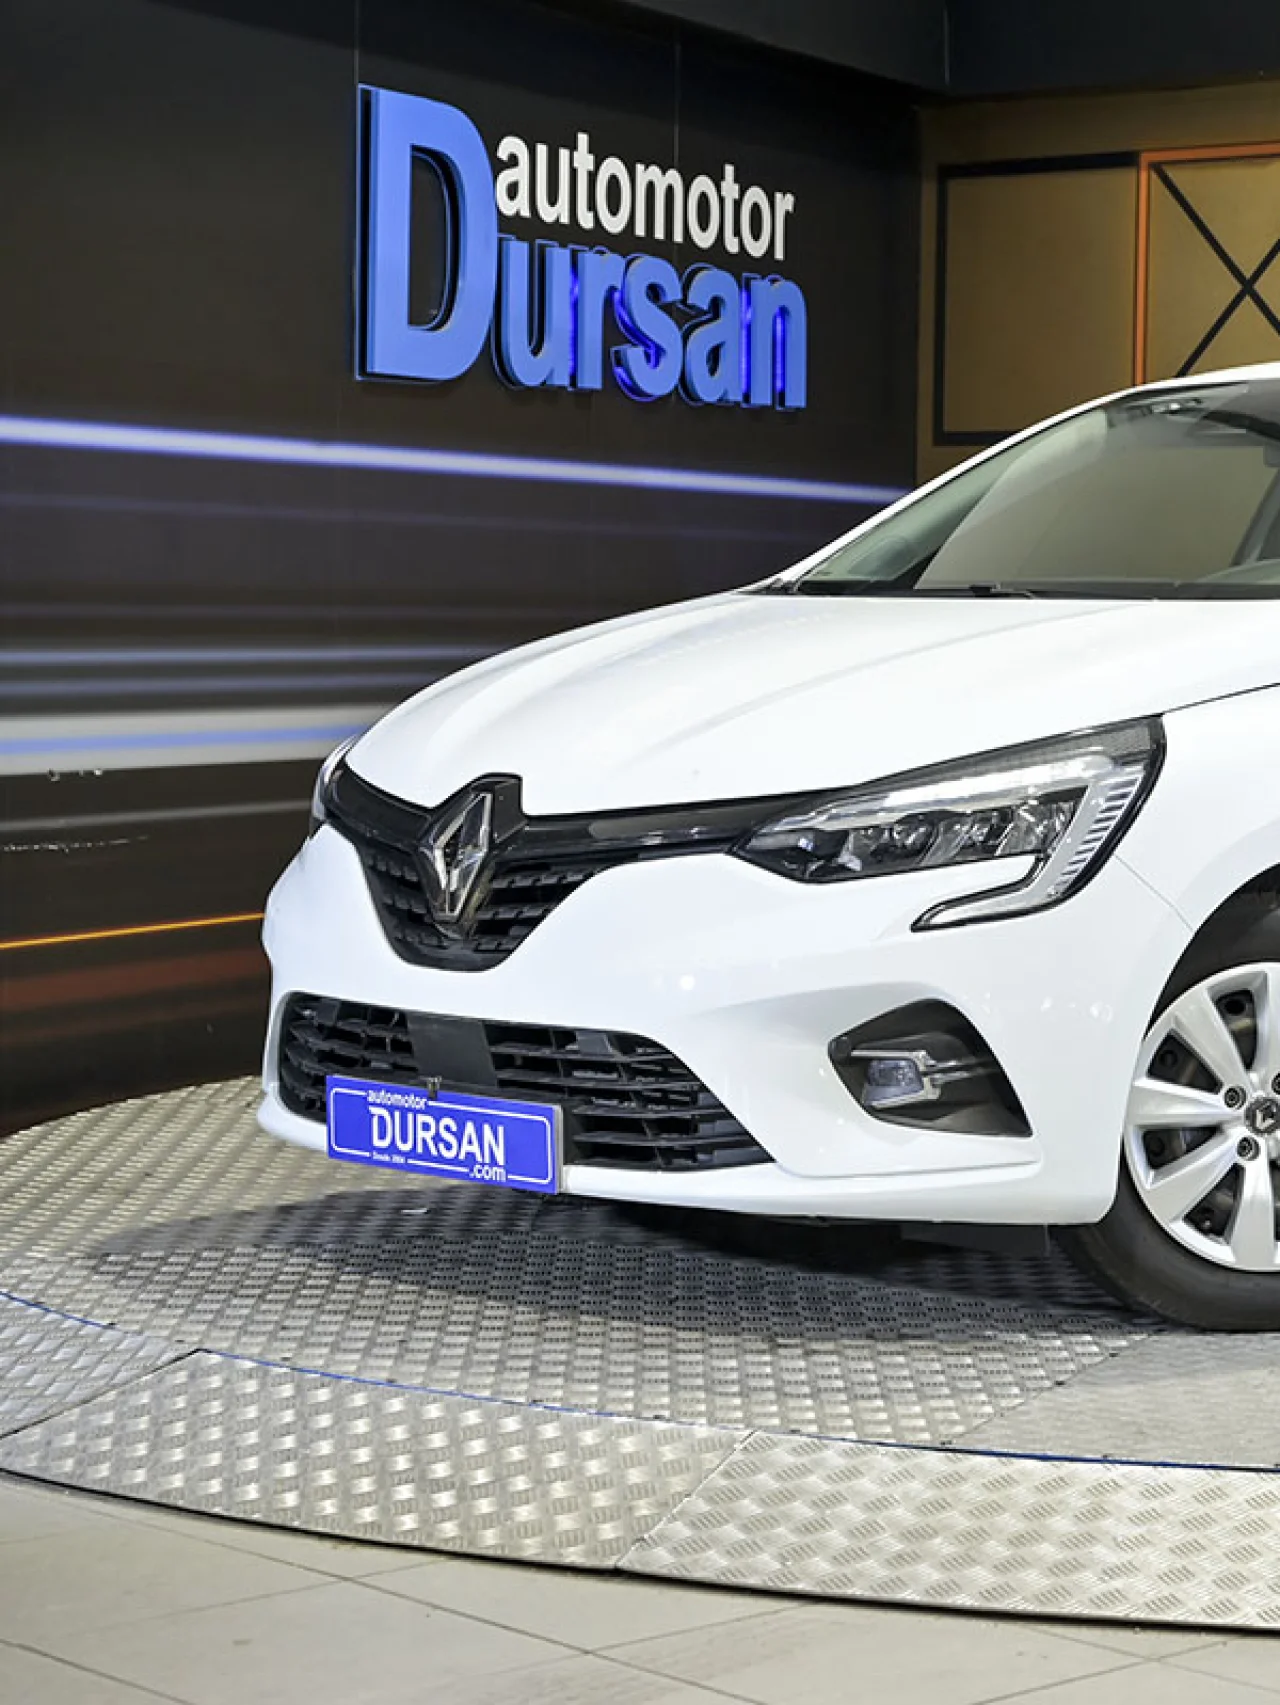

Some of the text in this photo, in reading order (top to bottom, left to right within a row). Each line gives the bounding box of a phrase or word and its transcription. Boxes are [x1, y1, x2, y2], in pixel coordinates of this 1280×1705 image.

[496, 132, 795, 260] automotor
[356, 83, 808, 409] Dursan
[367, 1089, 427, 1110] automotor
[369, 1106, 505, 1166] DURSAN
[469, 1164, 507, 1183] .com
